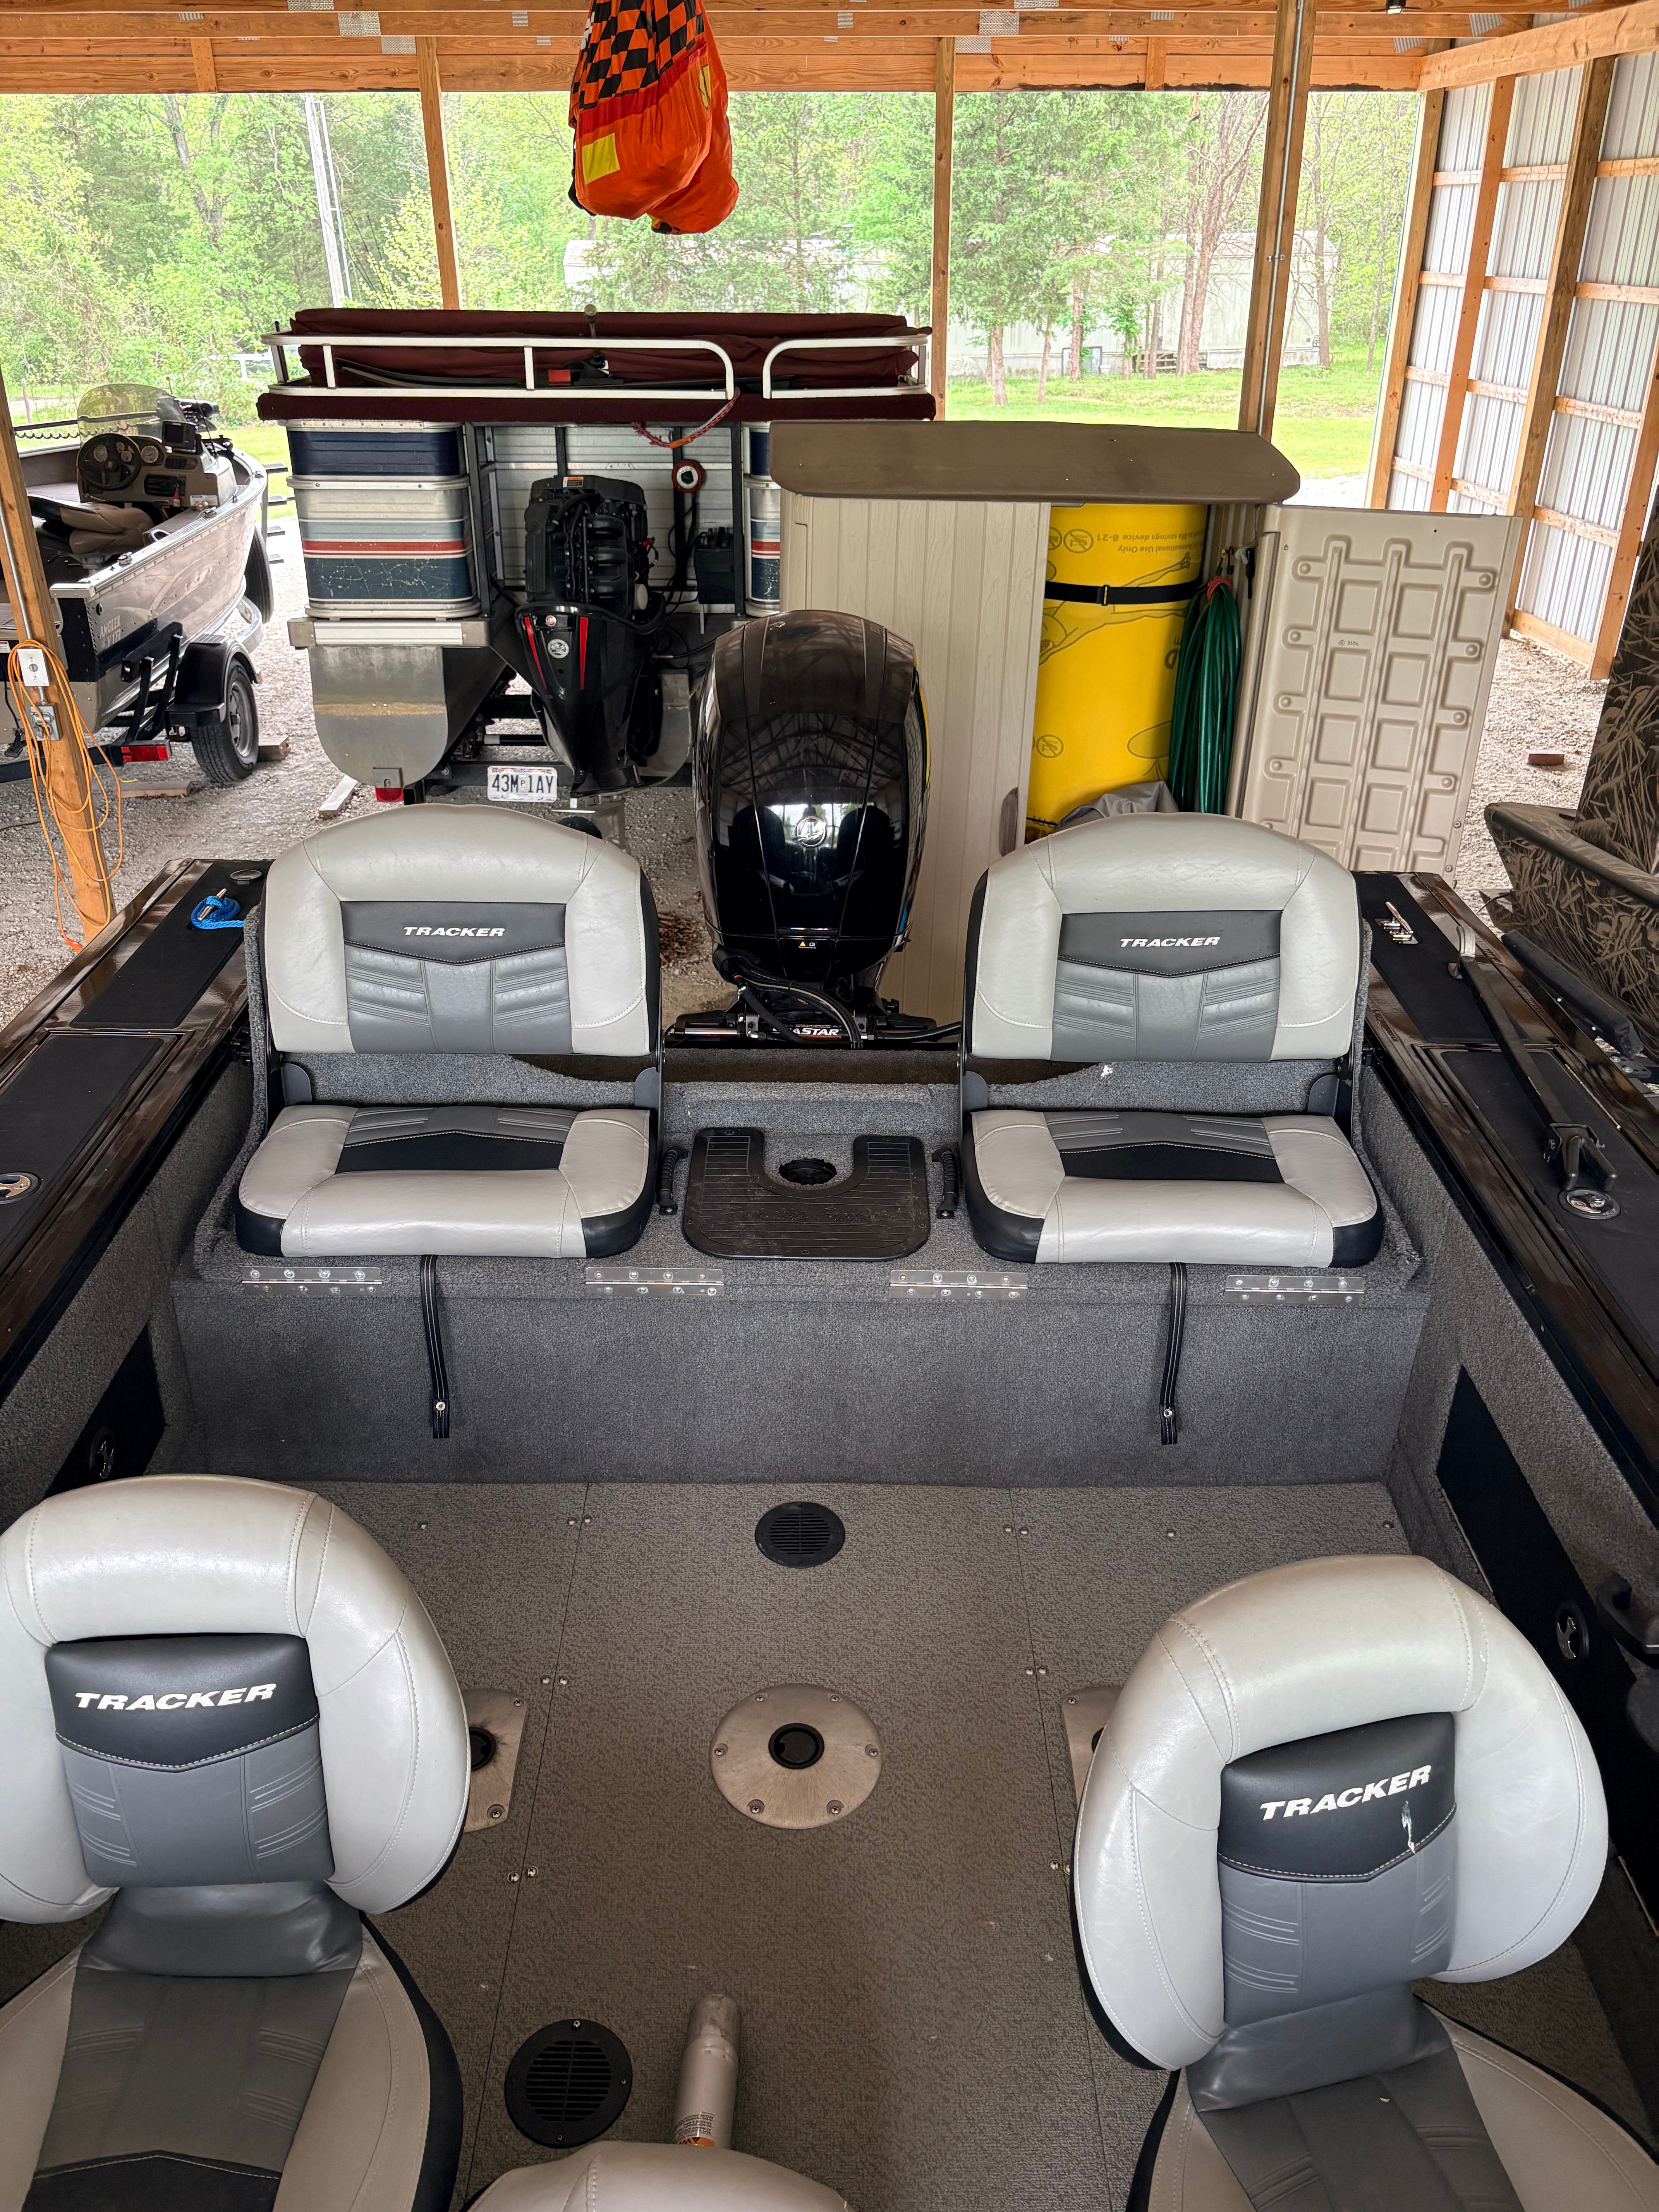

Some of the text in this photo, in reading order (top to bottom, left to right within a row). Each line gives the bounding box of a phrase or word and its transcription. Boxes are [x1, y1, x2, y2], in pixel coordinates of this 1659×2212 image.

[1097, 534, 1119, 542] 8-21
[1152, 533, 1178, 541] savings
[1118, 544, 1138, 553] Only
[100, 615, 120, 639] ANGLER
[404, 927, 505, 937] TRACKER
[1120, 937, 1221, 947] TRACKER
[772, 1027, 840, 1036] ASTAR
[75, 1683, 277, 1710] TRACKER
[1260, 1765, 1432, 1820] TRACKER
